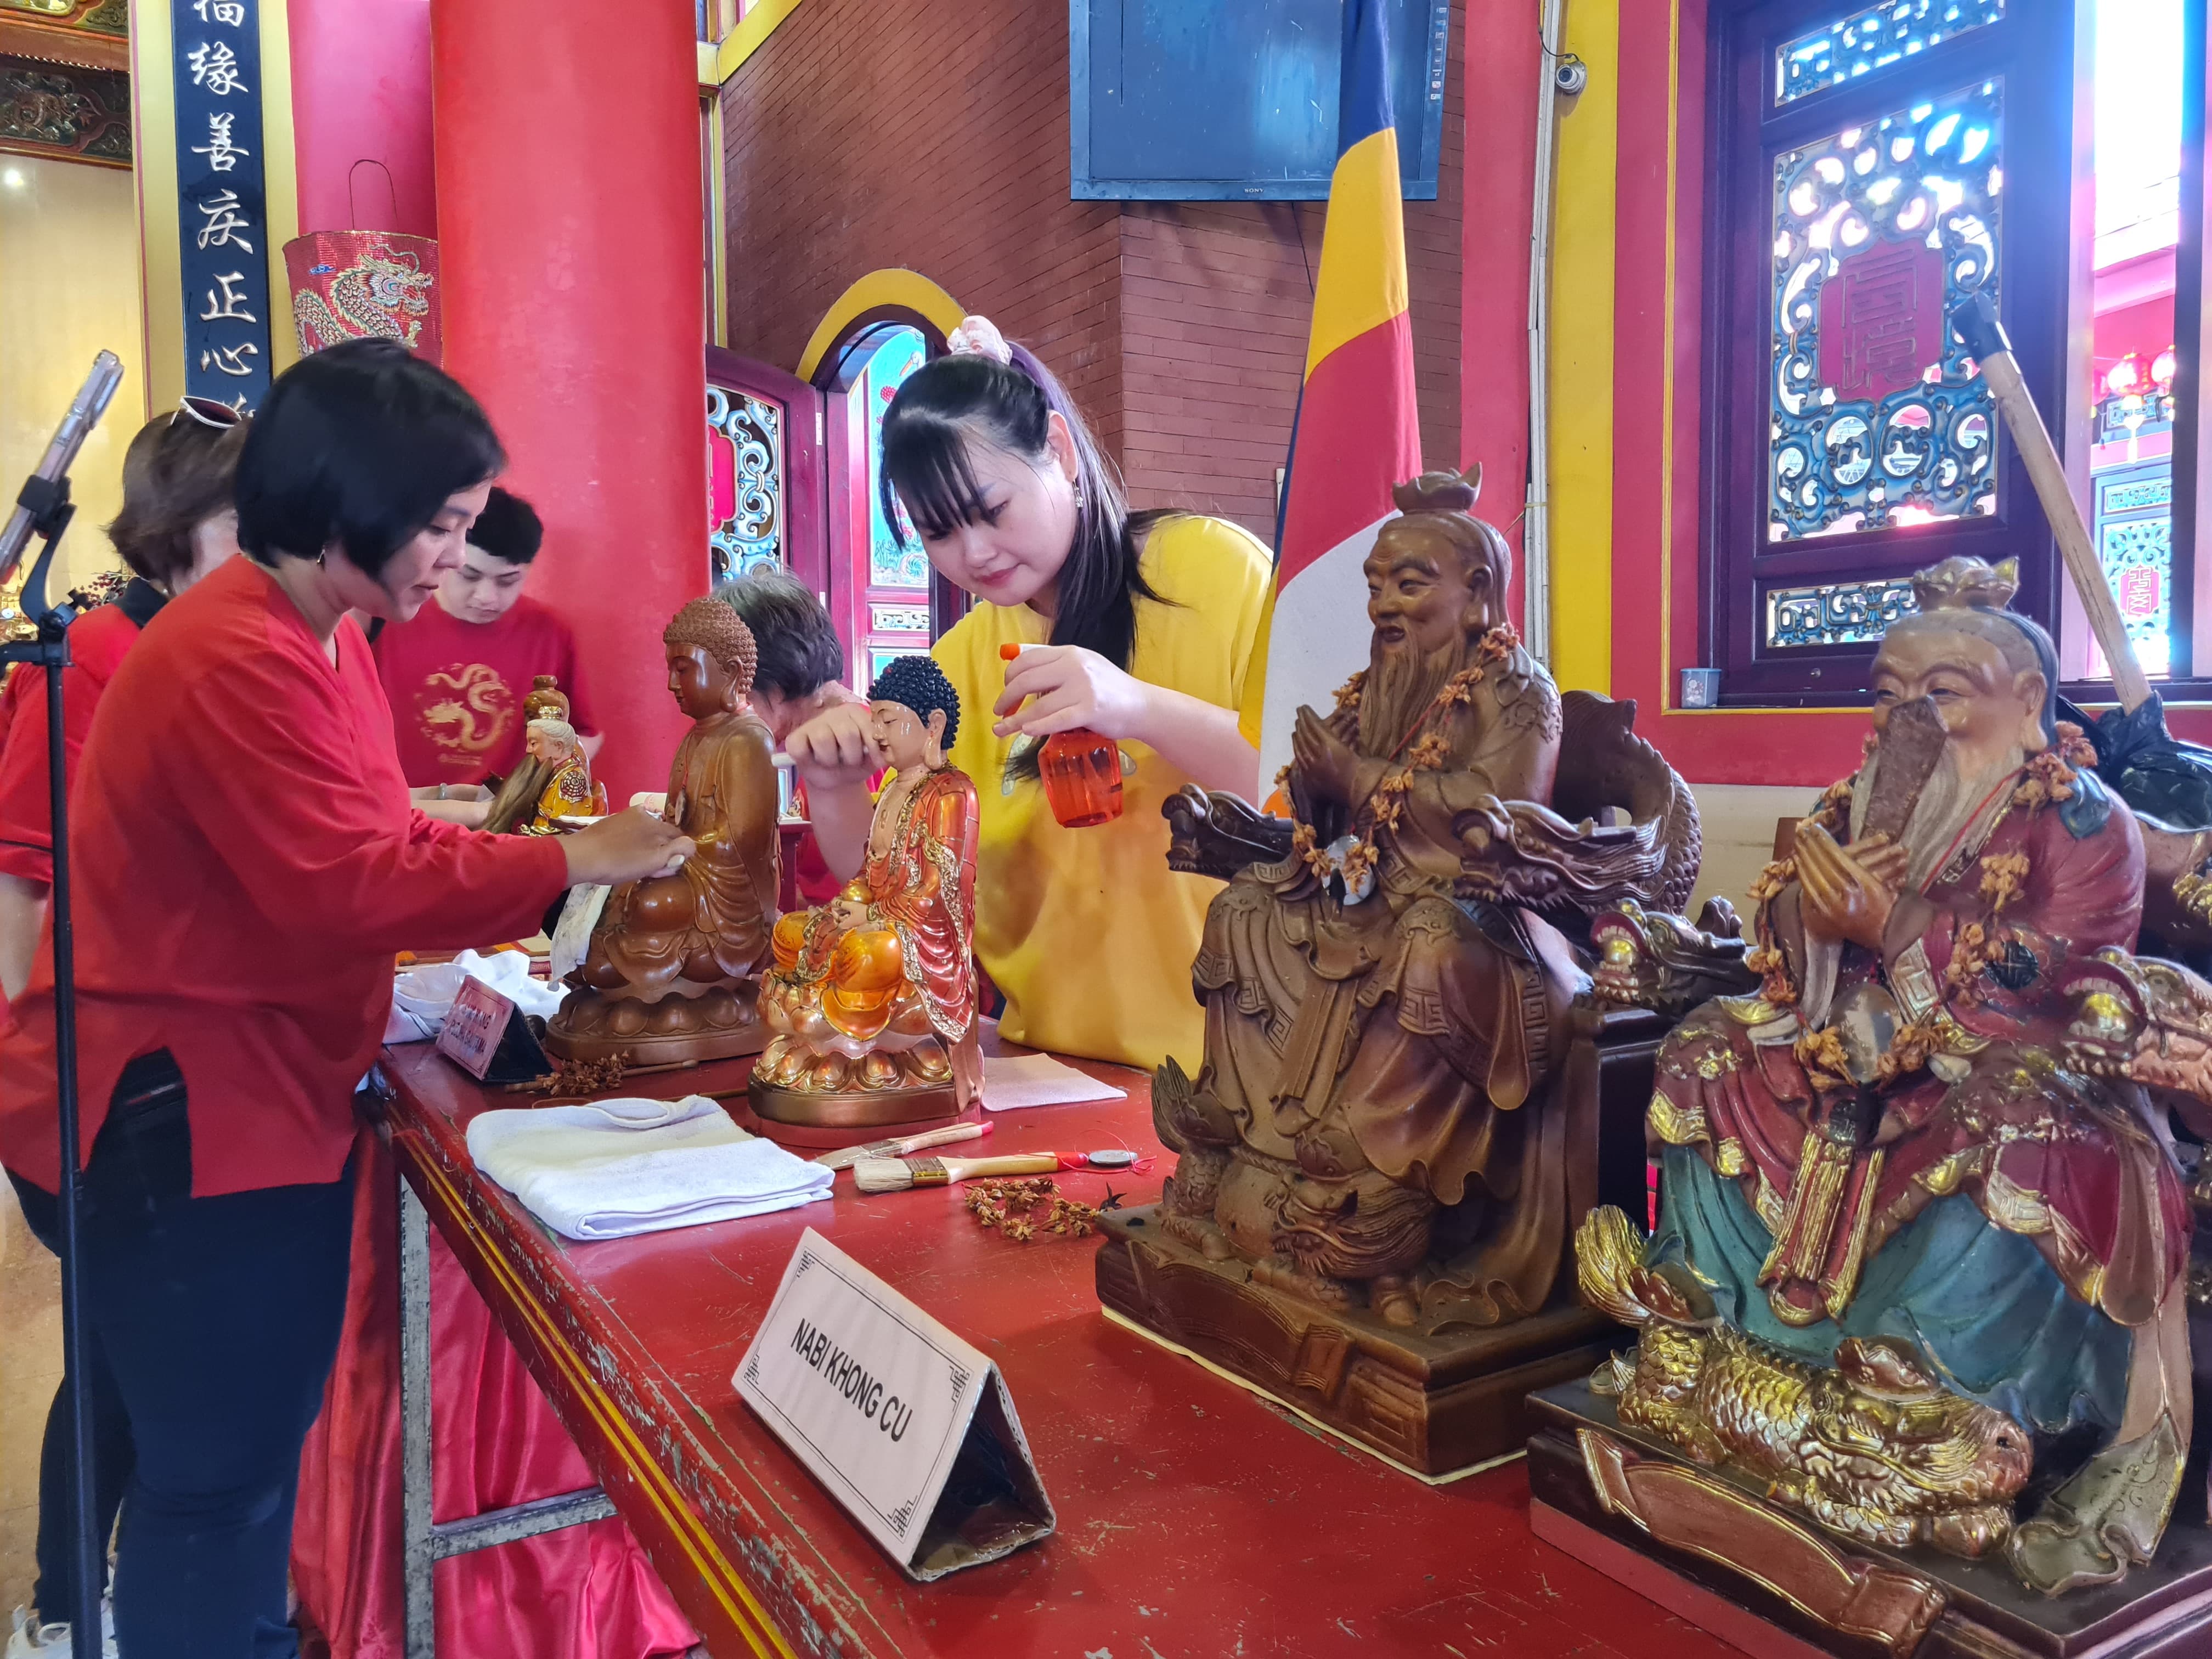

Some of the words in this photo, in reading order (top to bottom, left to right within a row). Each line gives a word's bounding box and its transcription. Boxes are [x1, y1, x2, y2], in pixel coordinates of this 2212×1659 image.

[791, 1318, 832, 1372] NABI
[824, 1346, 883, 1418] KHONG
[879, 1396, 913, 1442] CU
